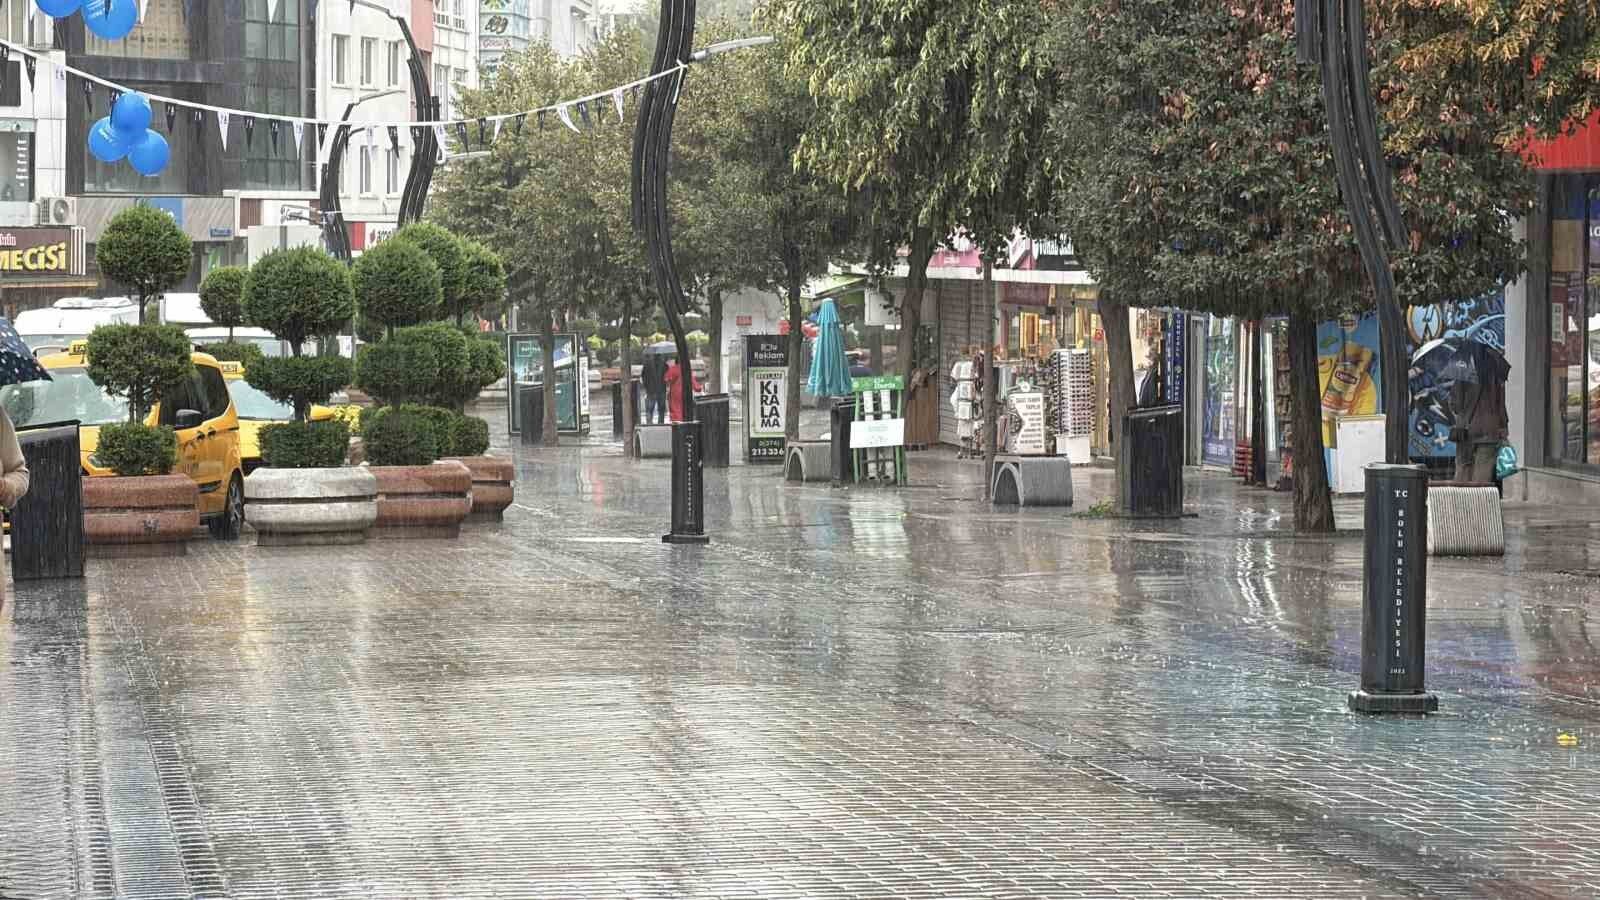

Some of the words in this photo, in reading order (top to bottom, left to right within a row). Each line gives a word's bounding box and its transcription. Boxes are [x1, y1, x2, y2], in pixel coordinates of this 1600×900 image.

[754, 351, 785, 360] Reklam
[760, 394, 780, 406] RA
[760, 405, 780, 419] LA
[761, 418, 781, 428] MA
[1396, 508, 1404, 548] BOLU
